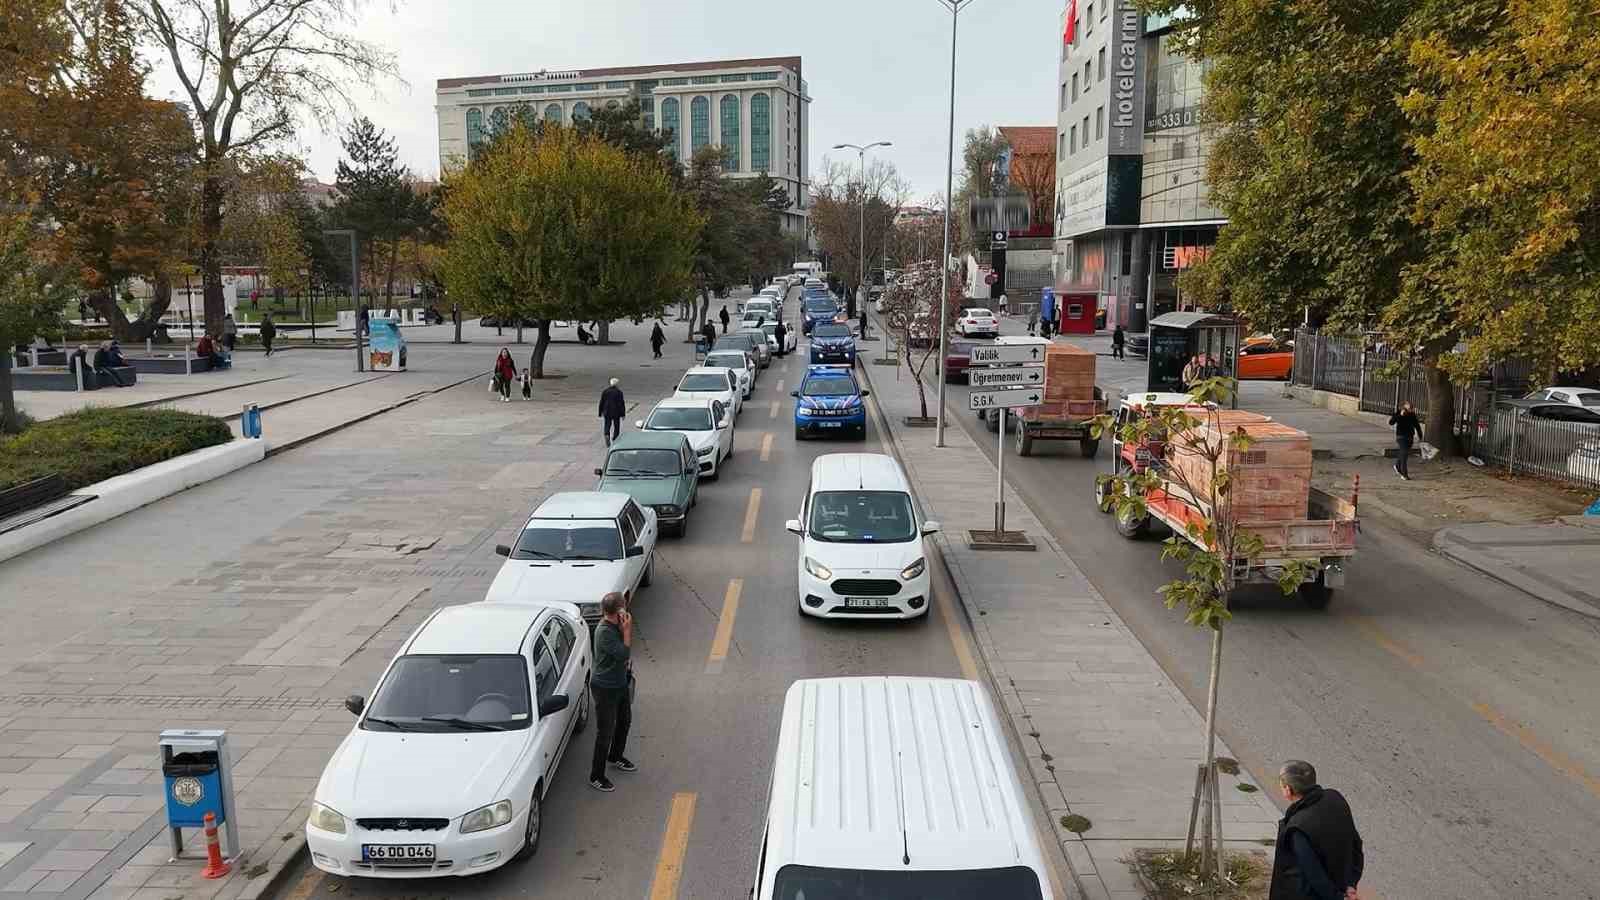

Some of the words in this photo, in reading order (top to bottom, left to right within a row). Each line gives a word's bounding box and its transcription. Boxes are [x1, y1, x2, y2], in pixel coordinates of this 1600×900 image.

[975, 348, 999, 361] Valilik
[369, 846, 385, 857] 66
[408, 846, 433, 857] 046
